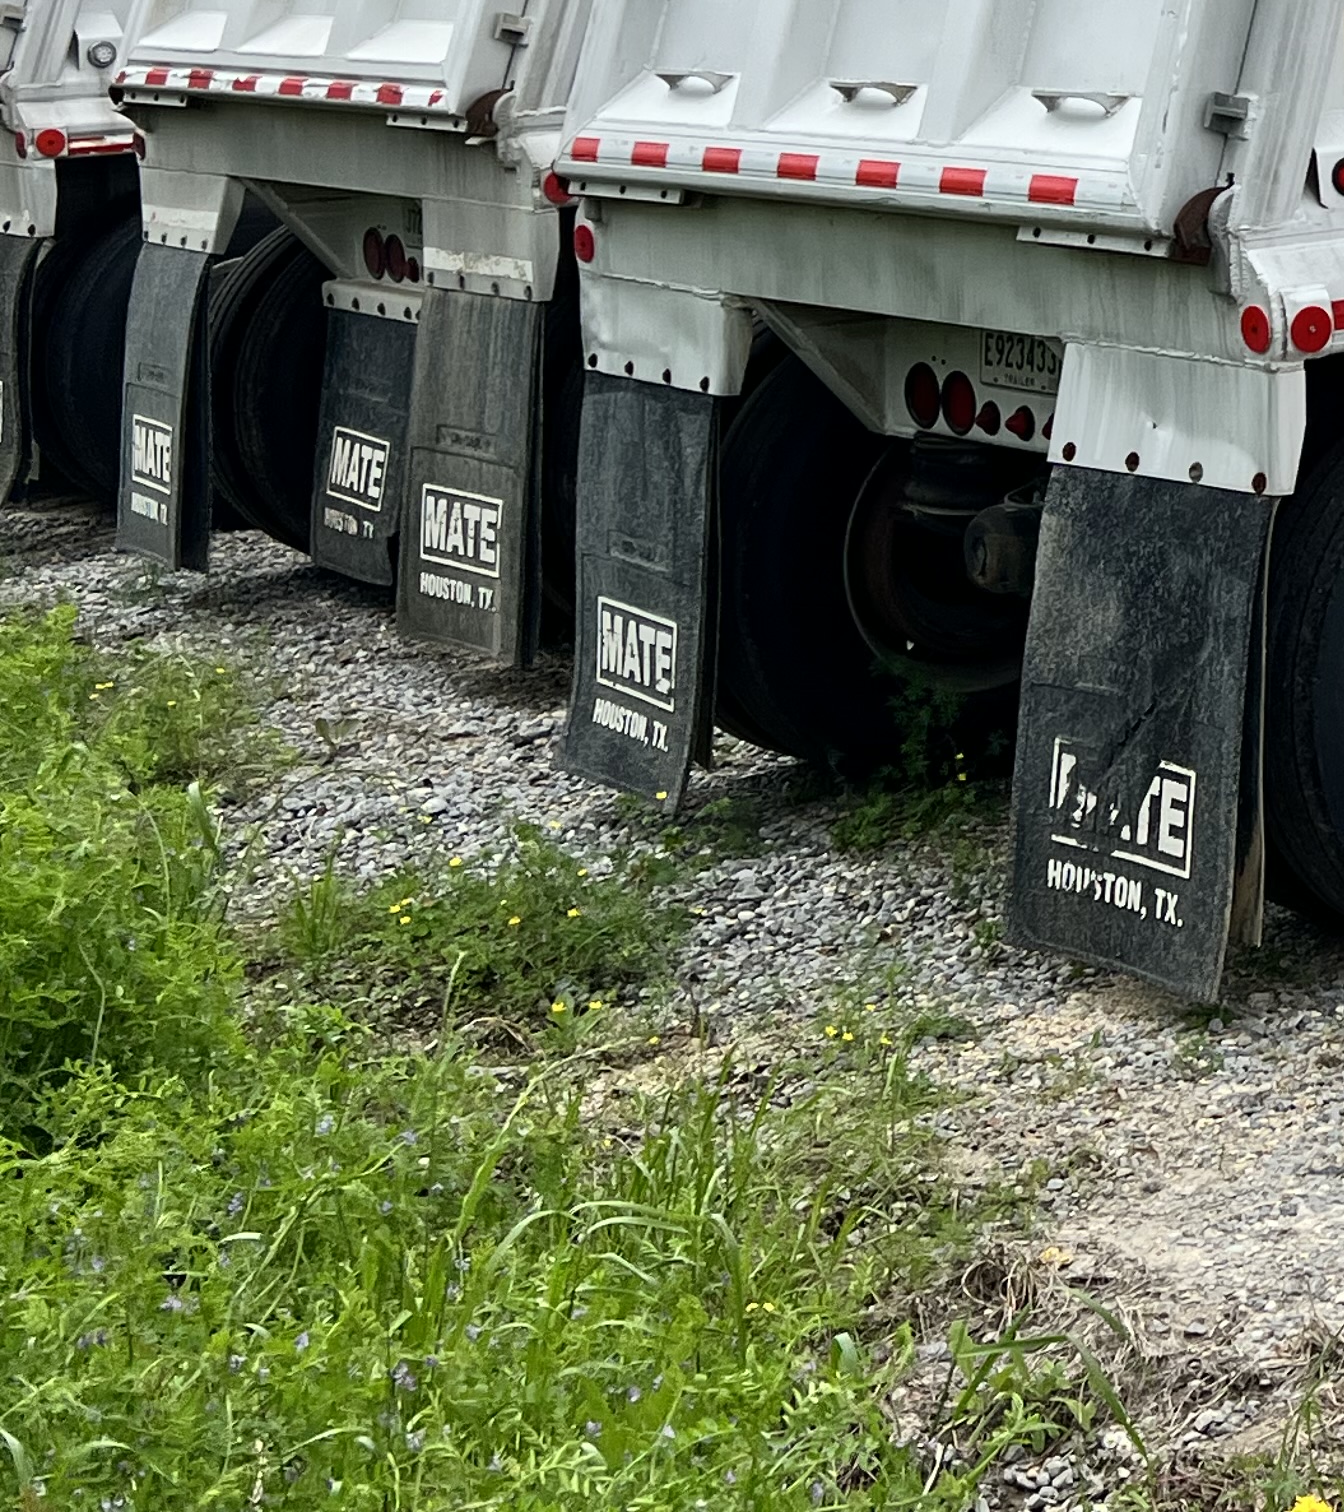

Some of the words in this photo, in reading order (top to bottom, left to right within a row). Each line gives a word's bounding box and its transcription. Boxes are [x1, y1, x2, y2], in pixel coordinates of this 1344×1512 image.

[133, 424, 171, 483] MATE
[330, 436, 386, 499] MATE
[425, 495, 498, 564] MATE
[601, 609, 673, 695] MATE
[592, 697, 650, 748] HOUSTON,
[652, 719, 669, 753] TX.
[1047, 858, 1148, 921] HOUSTON,
[1154, 887, 1184, 928] TX.
